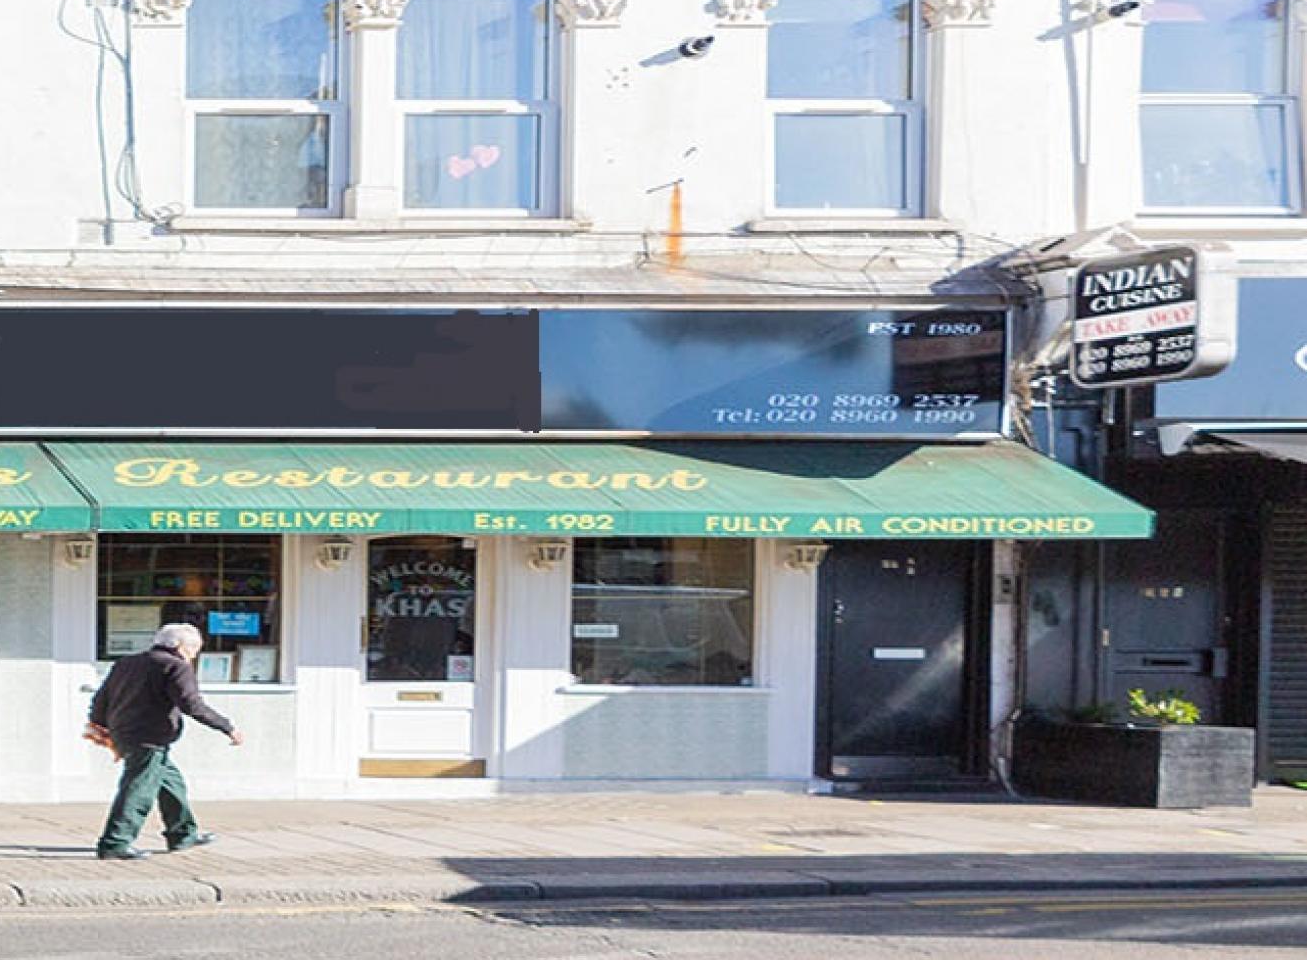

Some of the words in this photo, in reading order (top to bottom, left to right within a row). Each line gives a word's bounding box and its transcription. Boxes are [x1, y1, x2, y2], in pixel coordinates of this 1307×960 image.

[1082, 257, 1194, 297] INDIAN
[1089, 283, 1183, 312] CUISINE
[868, 322, 917, 336] EST
[927, 322, 981, 336] 1980
[1082, 317, 1130, 339] TAKE
[1146, 305, 1194, 328] AWAY
[767, 393, 820, 408] 020
[832, 393, 901, 408] 8969
[913, 393, 979, 408] 2537
[712, 408, 761, 424] Tel:
[765, 408, 817, 424] 020
[830, 408, 898, 424] 8960
[912, 408, 976, 424] 1990
[113, 456, 709, 491] Restaurant
[150, 510, 222, 528] FREE
[237, 510, 382, 528] DELIVERY
[474, 512, 528, 529] Est.
[545, 513, 615, 530] 1982
[705, 515, 791, 533] FULLY
[808, 516, 865, 534] AIR
[881, 516, 1096, 535] CONDITIONED
[371, 560, 472, 587] WELCOME
[408, 584, 434, 596] TO
[375, 593, 468, 617] KHAS
